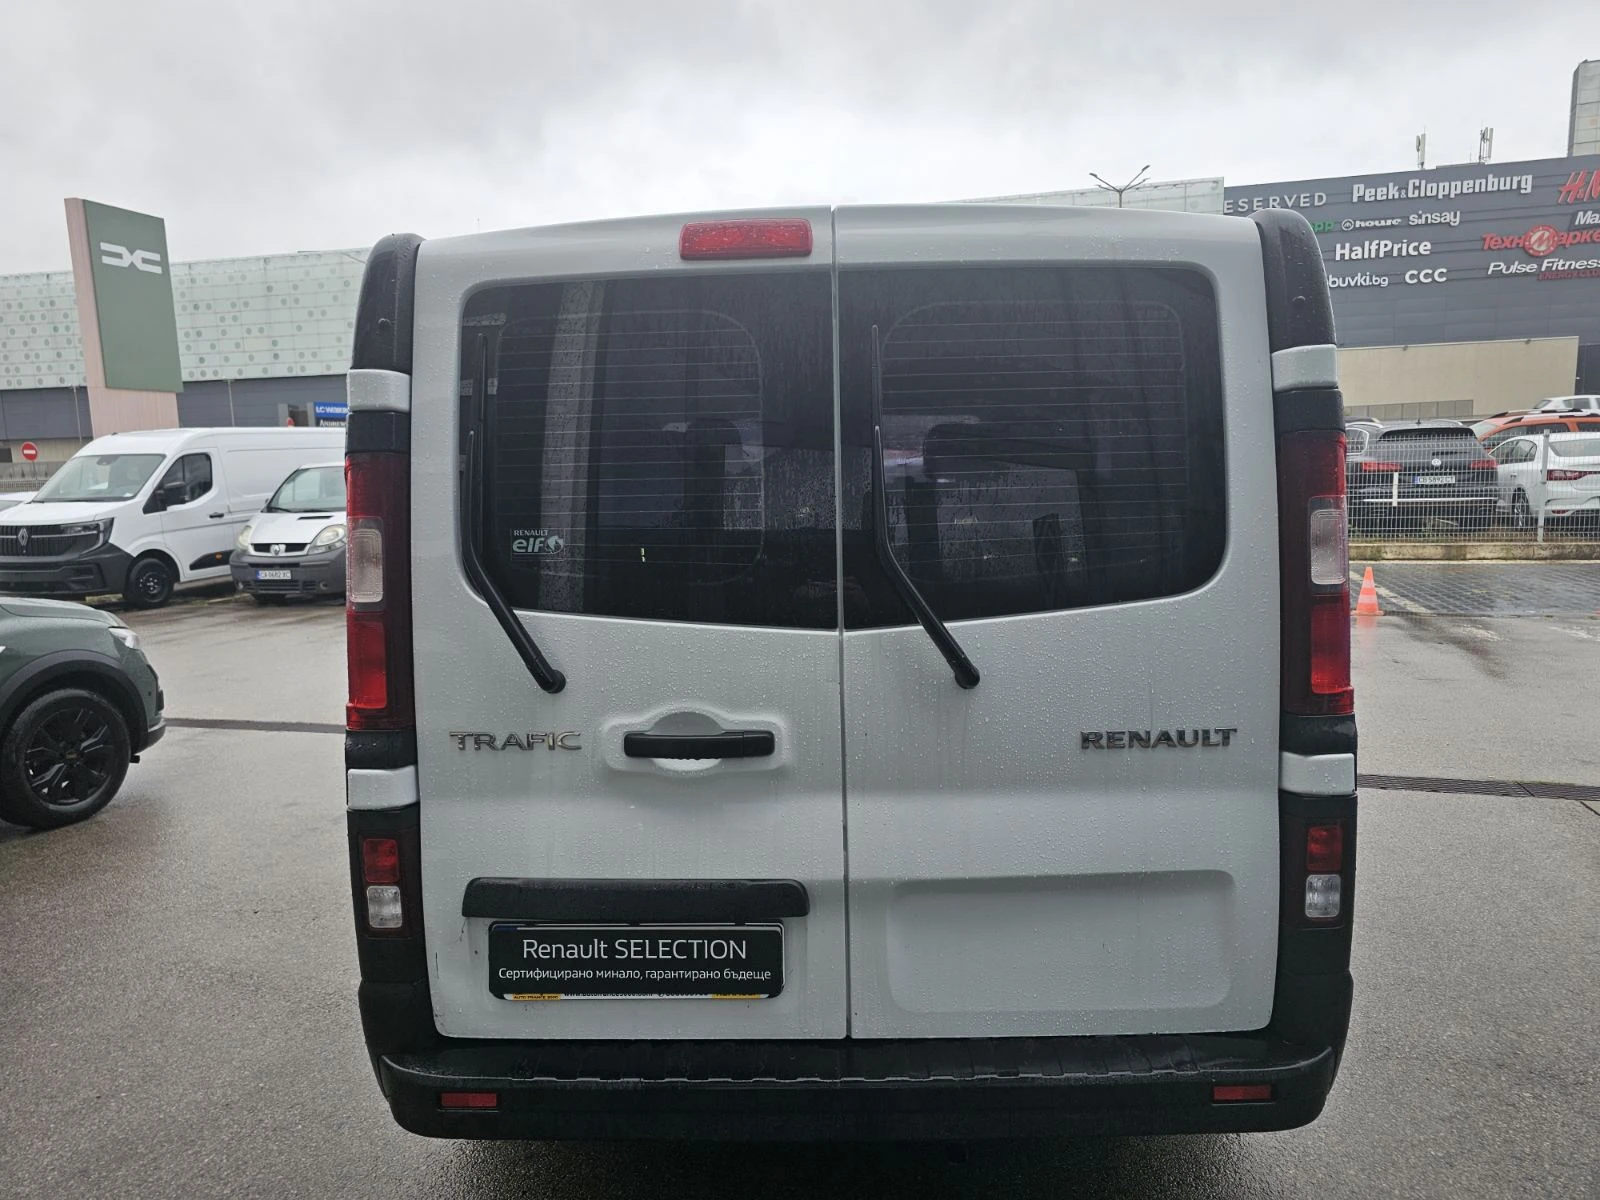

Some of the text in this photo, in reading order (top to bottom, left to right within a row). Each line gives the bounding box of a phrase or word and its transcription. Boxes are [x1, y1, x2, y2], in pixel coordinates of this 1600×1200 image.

[1409, 210, 1461, 227] sinsay
[1575, 210, 1600, 225] Ma
[1335, 239, 1432, 261] HalfPrice
[1488, 257, 1600, 275] Pulse Fitnes
[1405, 268, 1447, 284] CCC
[513, 529, 549, 537] RENAULT
[512, 537, 545, 553] elf
[449, 731, 582, 751] TRAFIC
[1080, 727, 1238, 750] RENAULT
[522, 938, 746, 959] Renault SELECTION
[498, 967, 771, 981] Сертифицирано минало, гарантирано бъдеще
